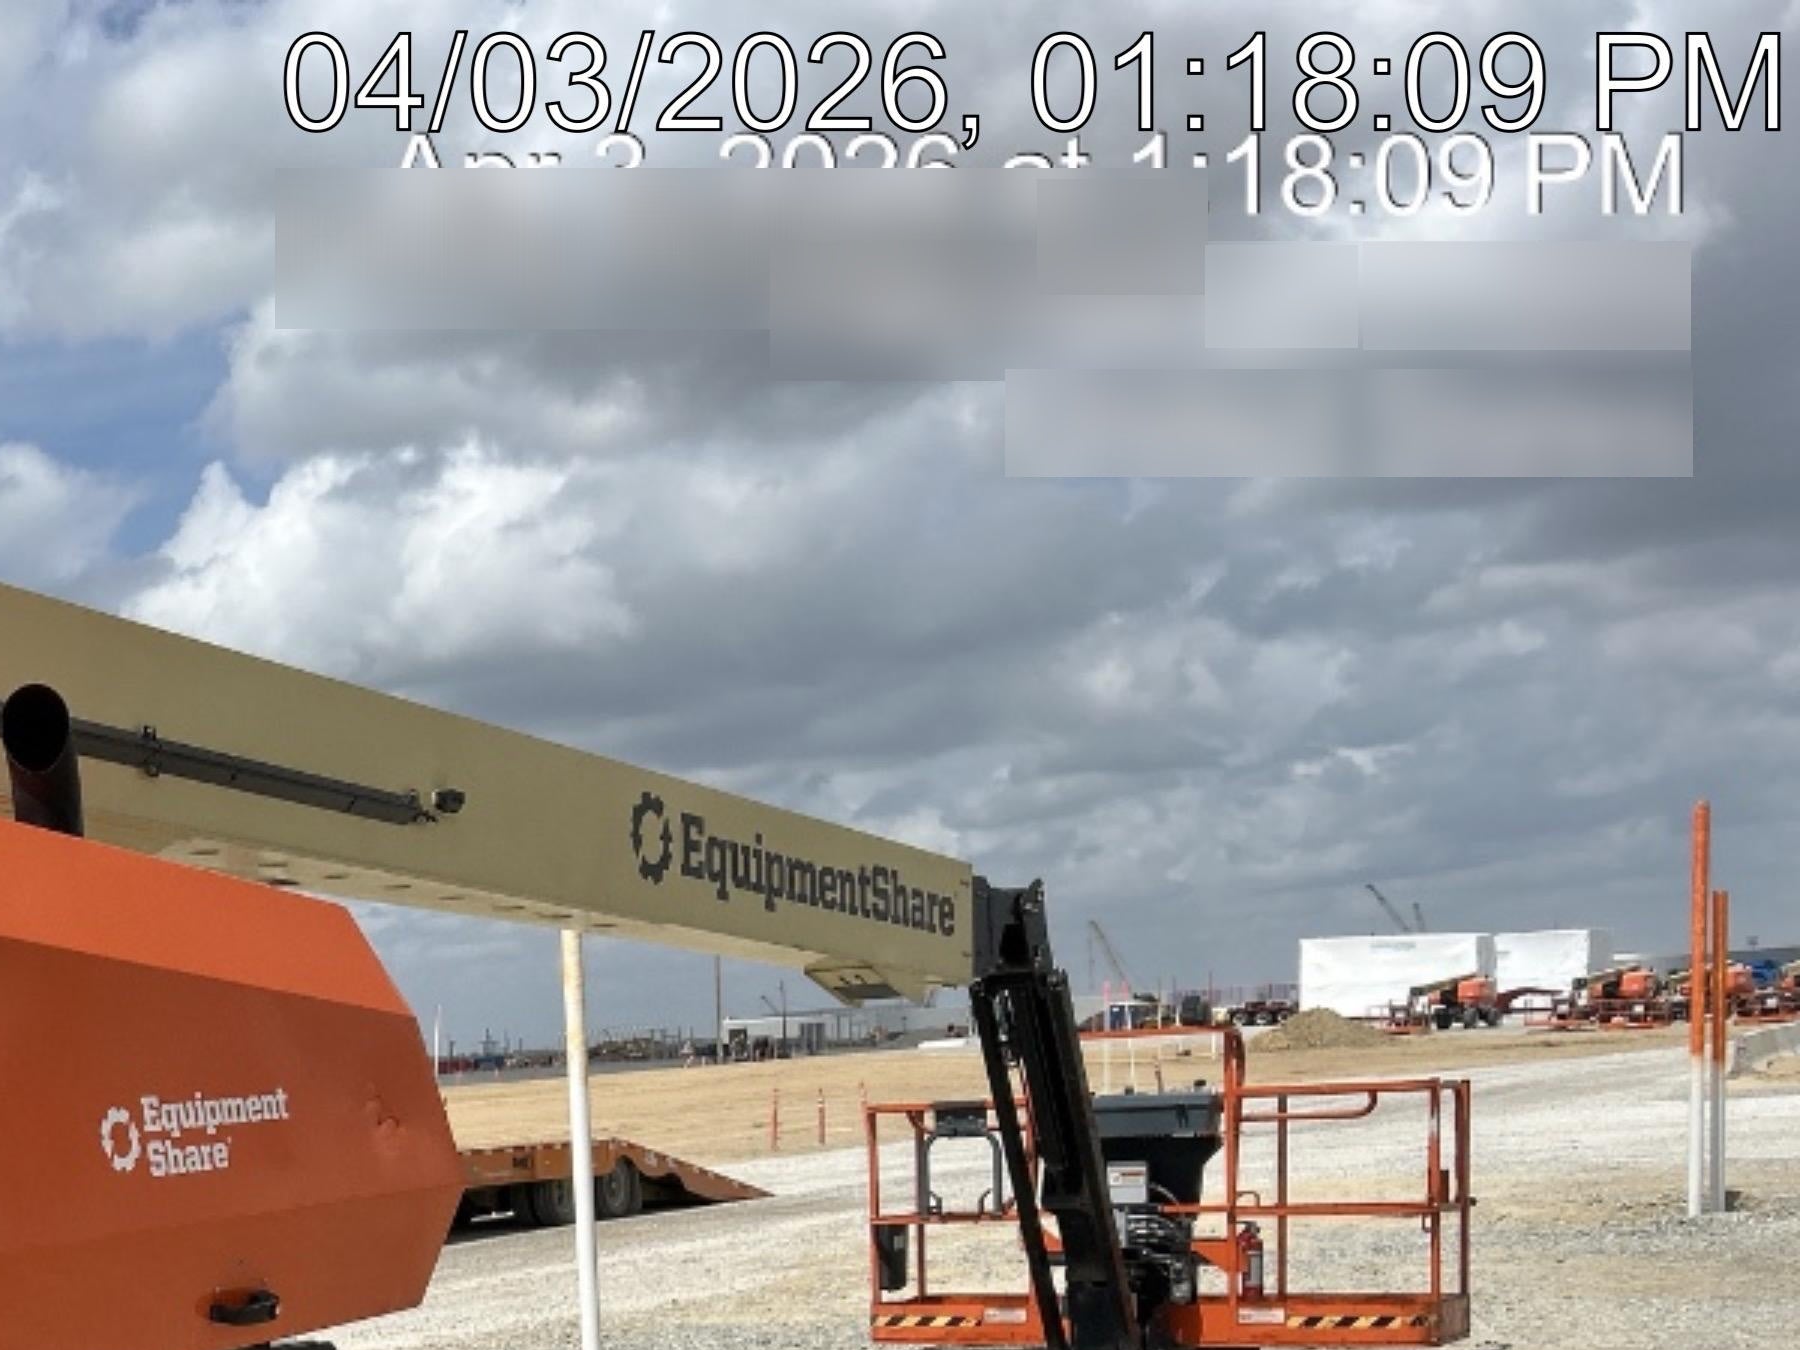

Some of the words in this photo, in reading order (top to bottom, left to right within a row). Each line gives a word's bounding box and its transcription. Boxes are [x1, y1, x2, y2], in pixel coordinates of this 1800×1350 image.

[679, 811, 957, 938] EquipmentShare
[140, 1087, 290, 1136] Equipment
[147, 1138, 231, 1177] Share
